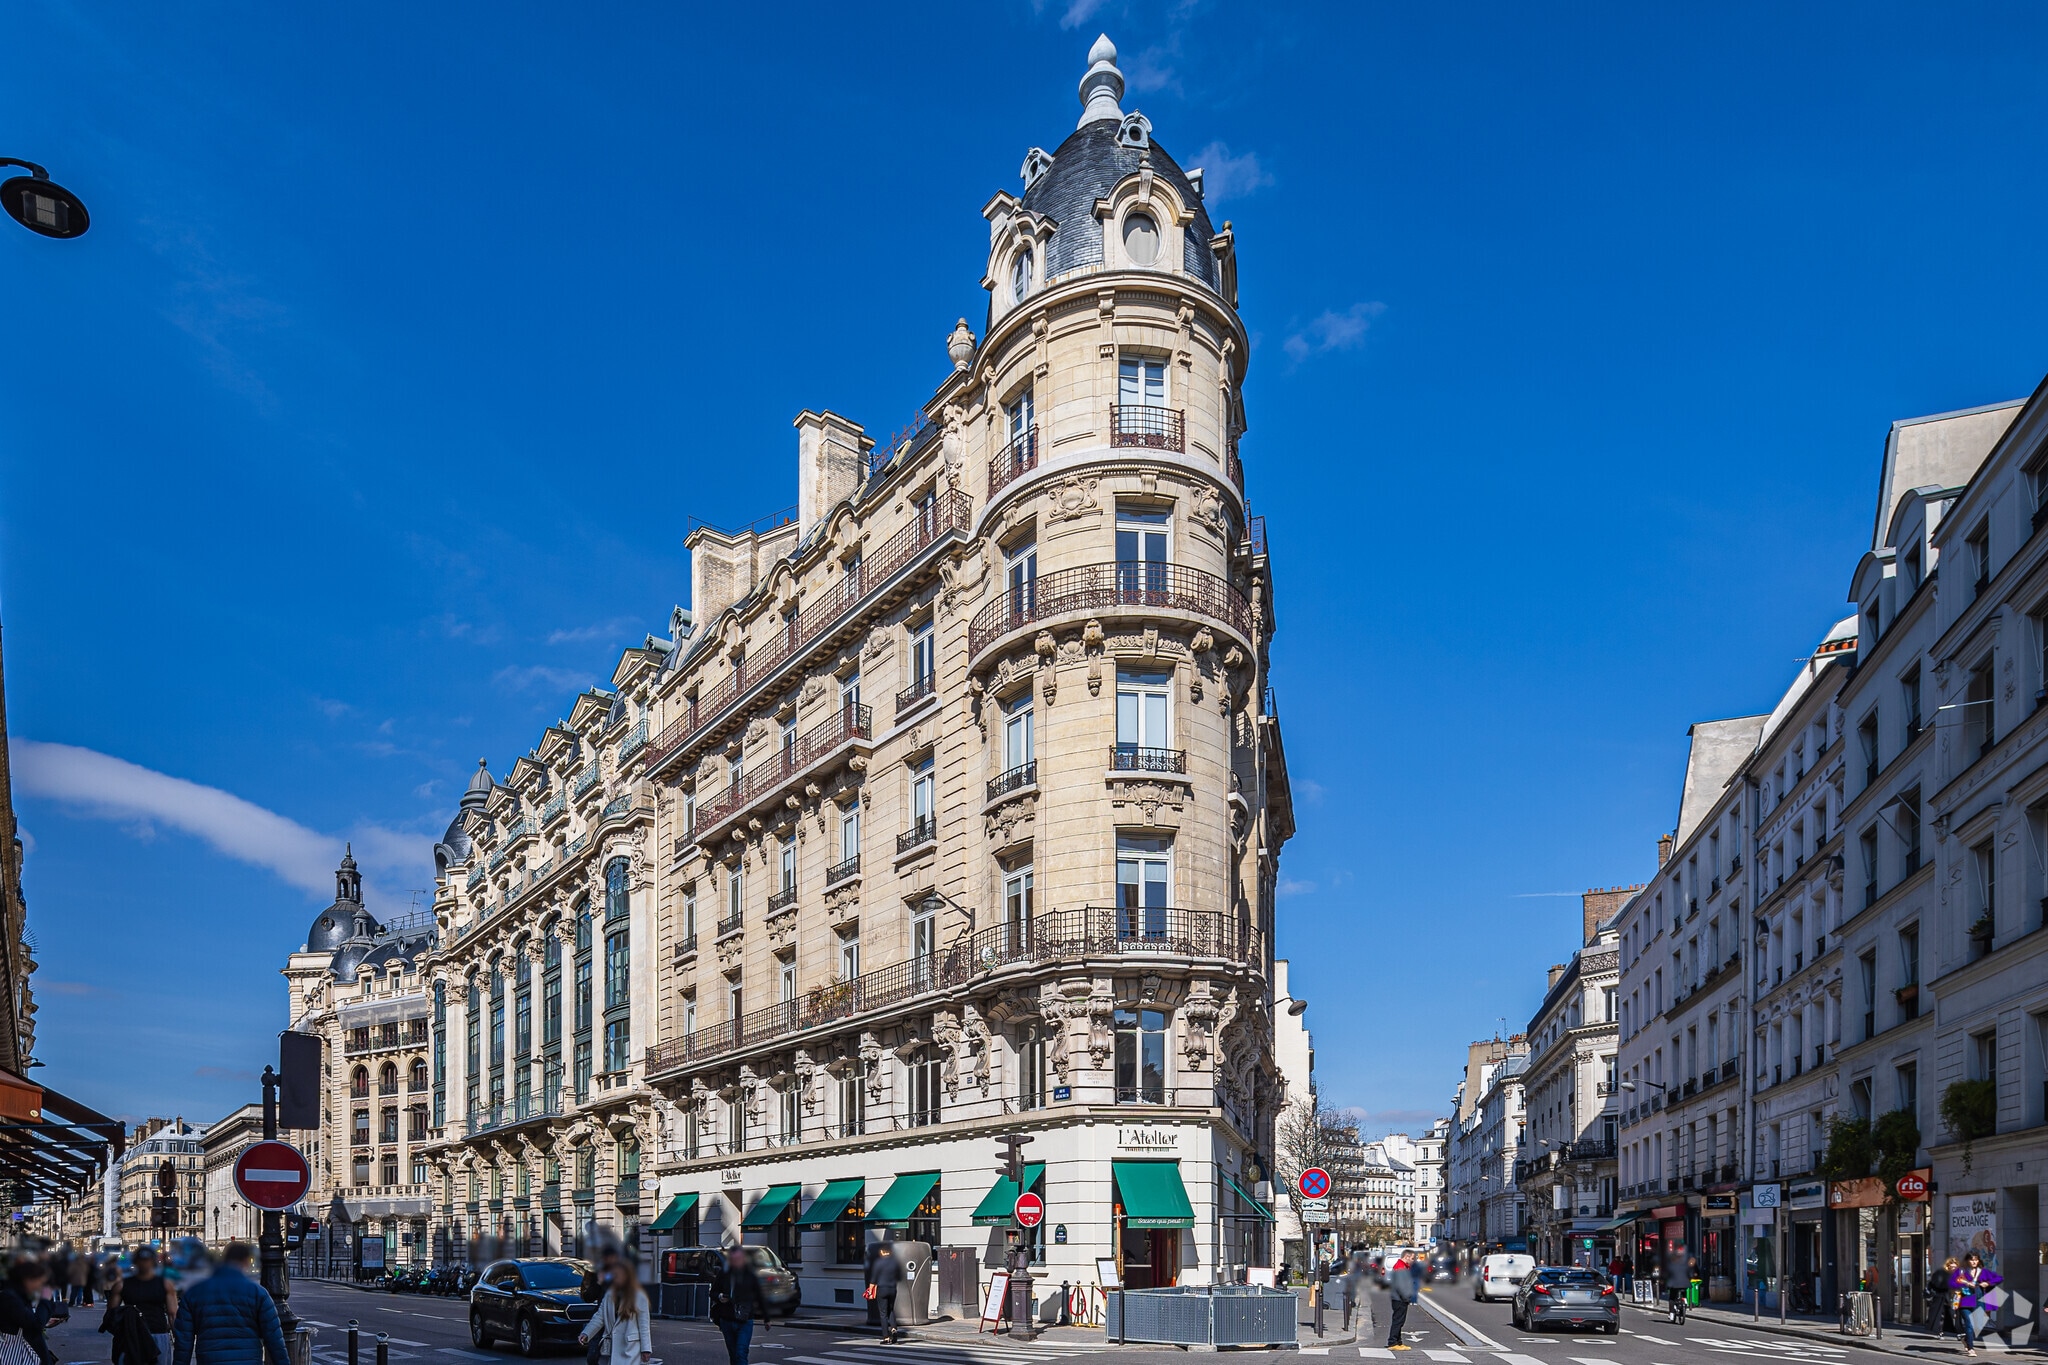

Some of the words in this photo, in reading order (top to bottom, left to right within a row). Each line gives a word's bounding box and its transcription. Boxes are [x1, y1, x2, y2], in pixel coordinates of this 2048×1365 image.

[1118, 1129, 1178, 1145] L'Atelier
[1901, 1177, 1924, 1190] ria
[1952, 1205, 1970, 1213] CURRENCY
[1952, 1215, 1989, 1228] EXCHANGE
[1684, 1337, 1850, 1353] BUS
